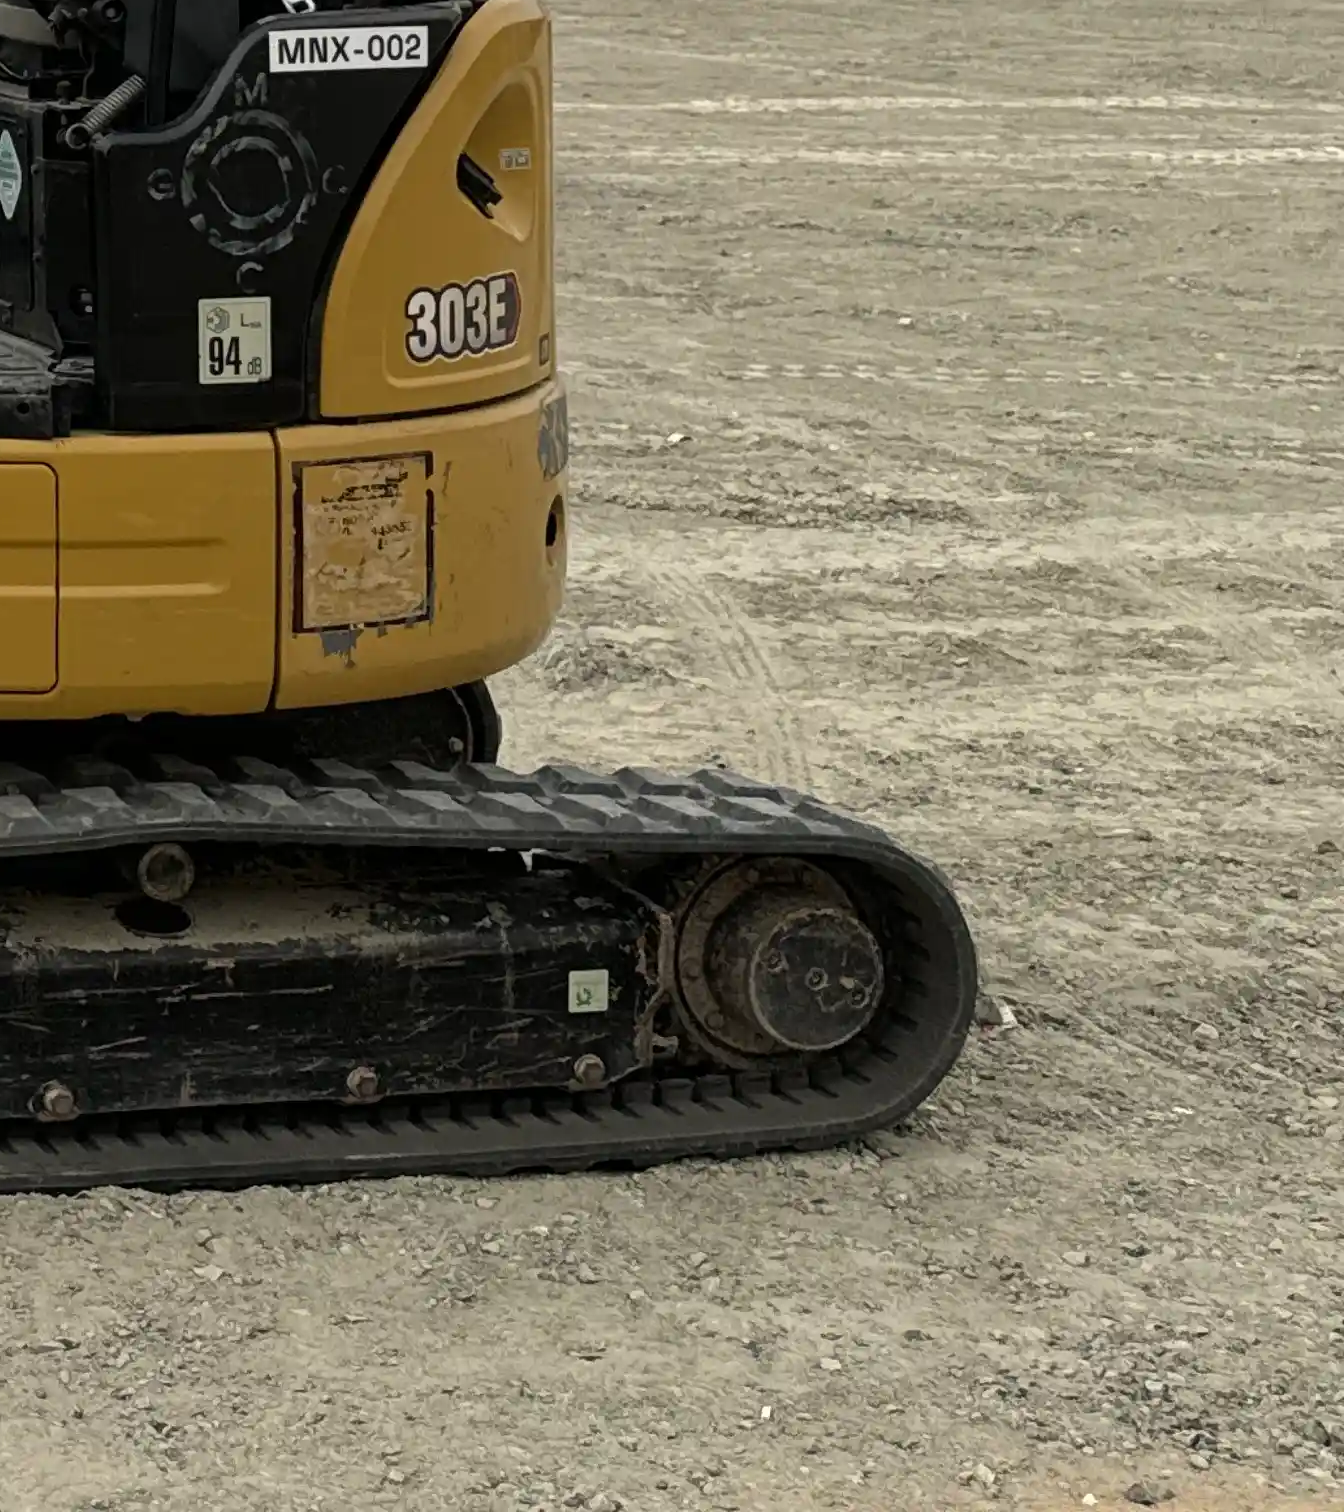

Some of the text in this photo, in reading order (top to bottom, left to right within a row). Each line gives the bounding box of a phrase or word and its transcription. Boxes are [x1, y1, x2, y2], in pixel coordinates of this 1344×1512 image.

[277, 34, 421, 64] MNX-002
[407, 278, 507, 358] 303E
[209, 336, 262, 376] 94 dB
